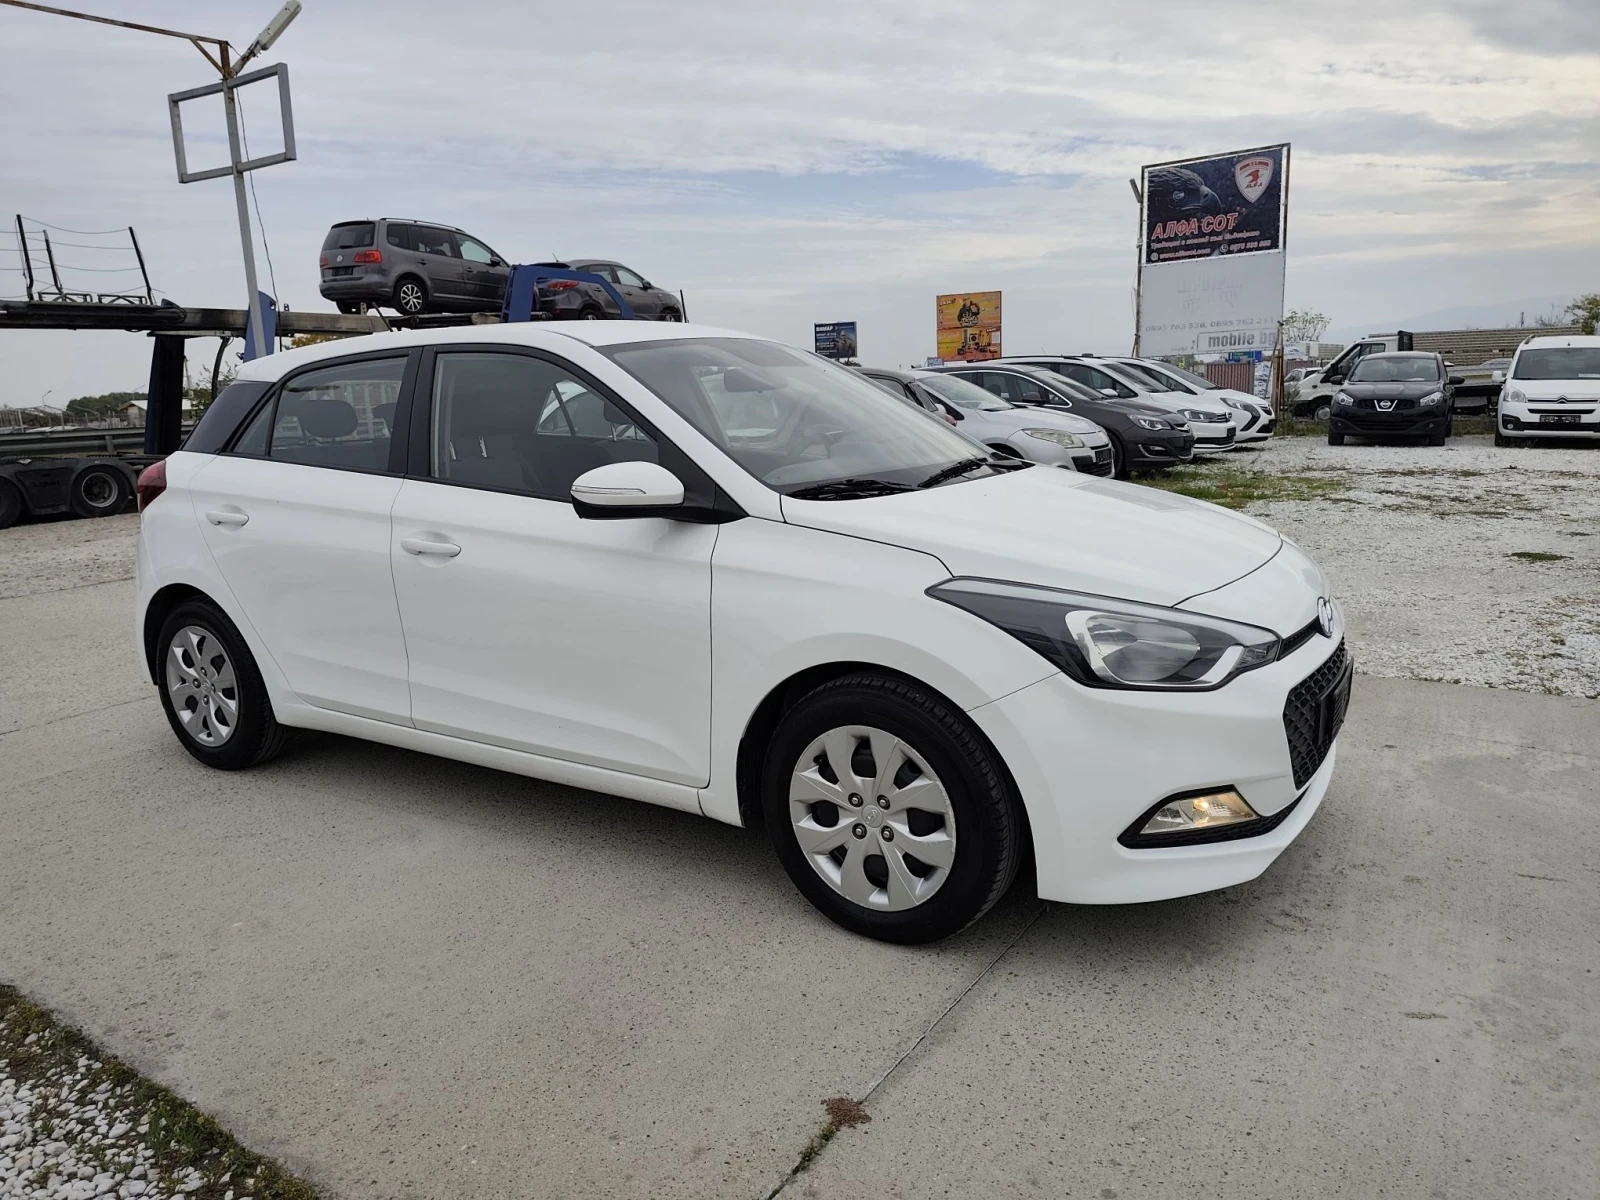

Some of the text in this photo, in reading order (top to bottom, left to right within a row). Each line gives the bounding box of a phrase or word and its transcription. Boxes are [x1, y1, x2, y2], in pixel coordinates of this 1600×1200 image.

[1151, 212, 1239, 240] АЛФА СОТ
[1208, 331, 1255, 348] mobile
